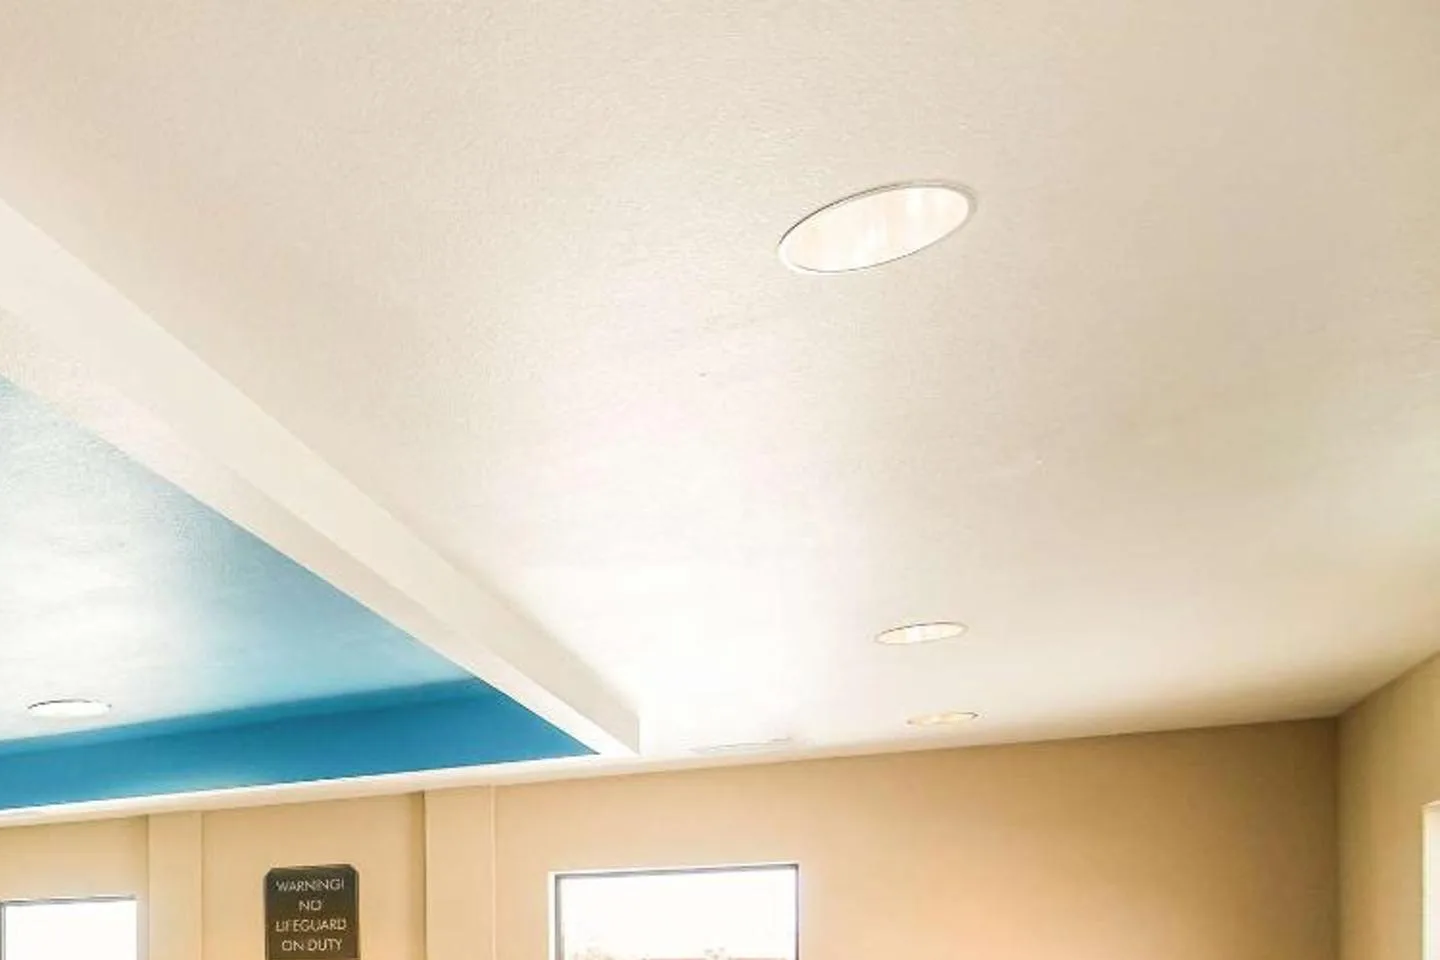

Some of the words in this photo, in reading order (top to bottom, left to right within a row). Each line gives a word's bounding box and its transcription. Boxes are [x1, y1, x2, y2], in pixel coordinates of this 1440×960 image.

[275, 878, 345, 892] WARNING!
[298, 899, 322, 911] NO
[275, 918, 347, 932] LIFEGUARD
[281, 940, 304, 951] ON
[308, 938, 343, 951] DUTY
